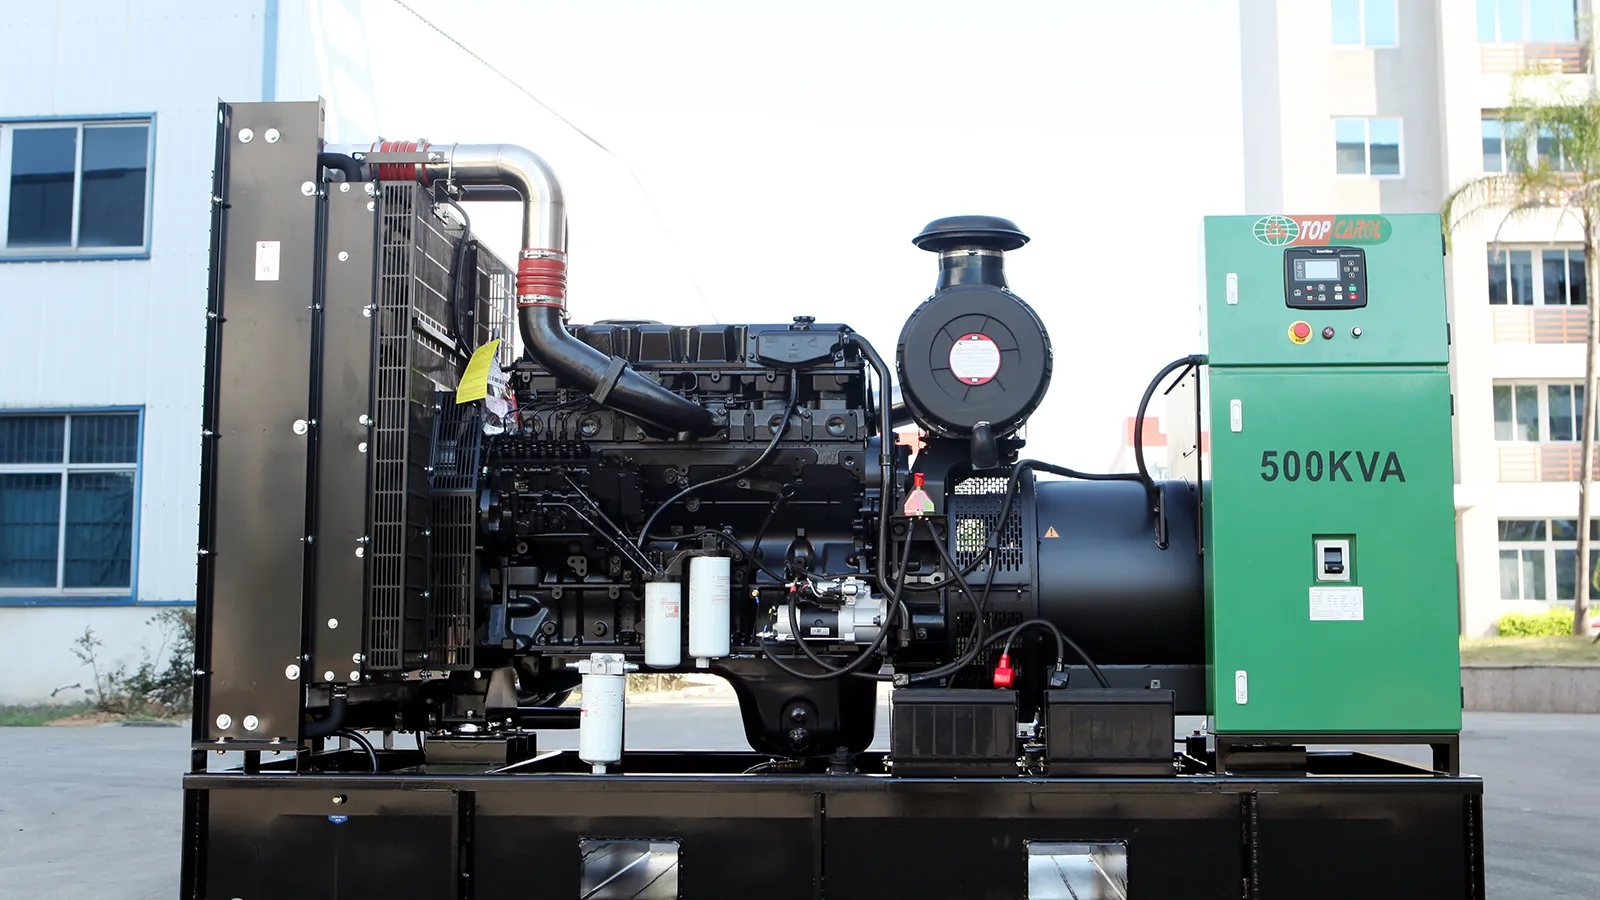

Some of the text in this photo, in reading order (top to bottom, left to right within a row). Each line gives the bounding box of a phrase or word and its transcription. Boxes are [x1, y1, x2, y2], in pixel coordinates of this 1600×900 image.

[1301, 220, 1381, 240] TOP CAROL
[1261, 450, 1406, 482] 500KVA
